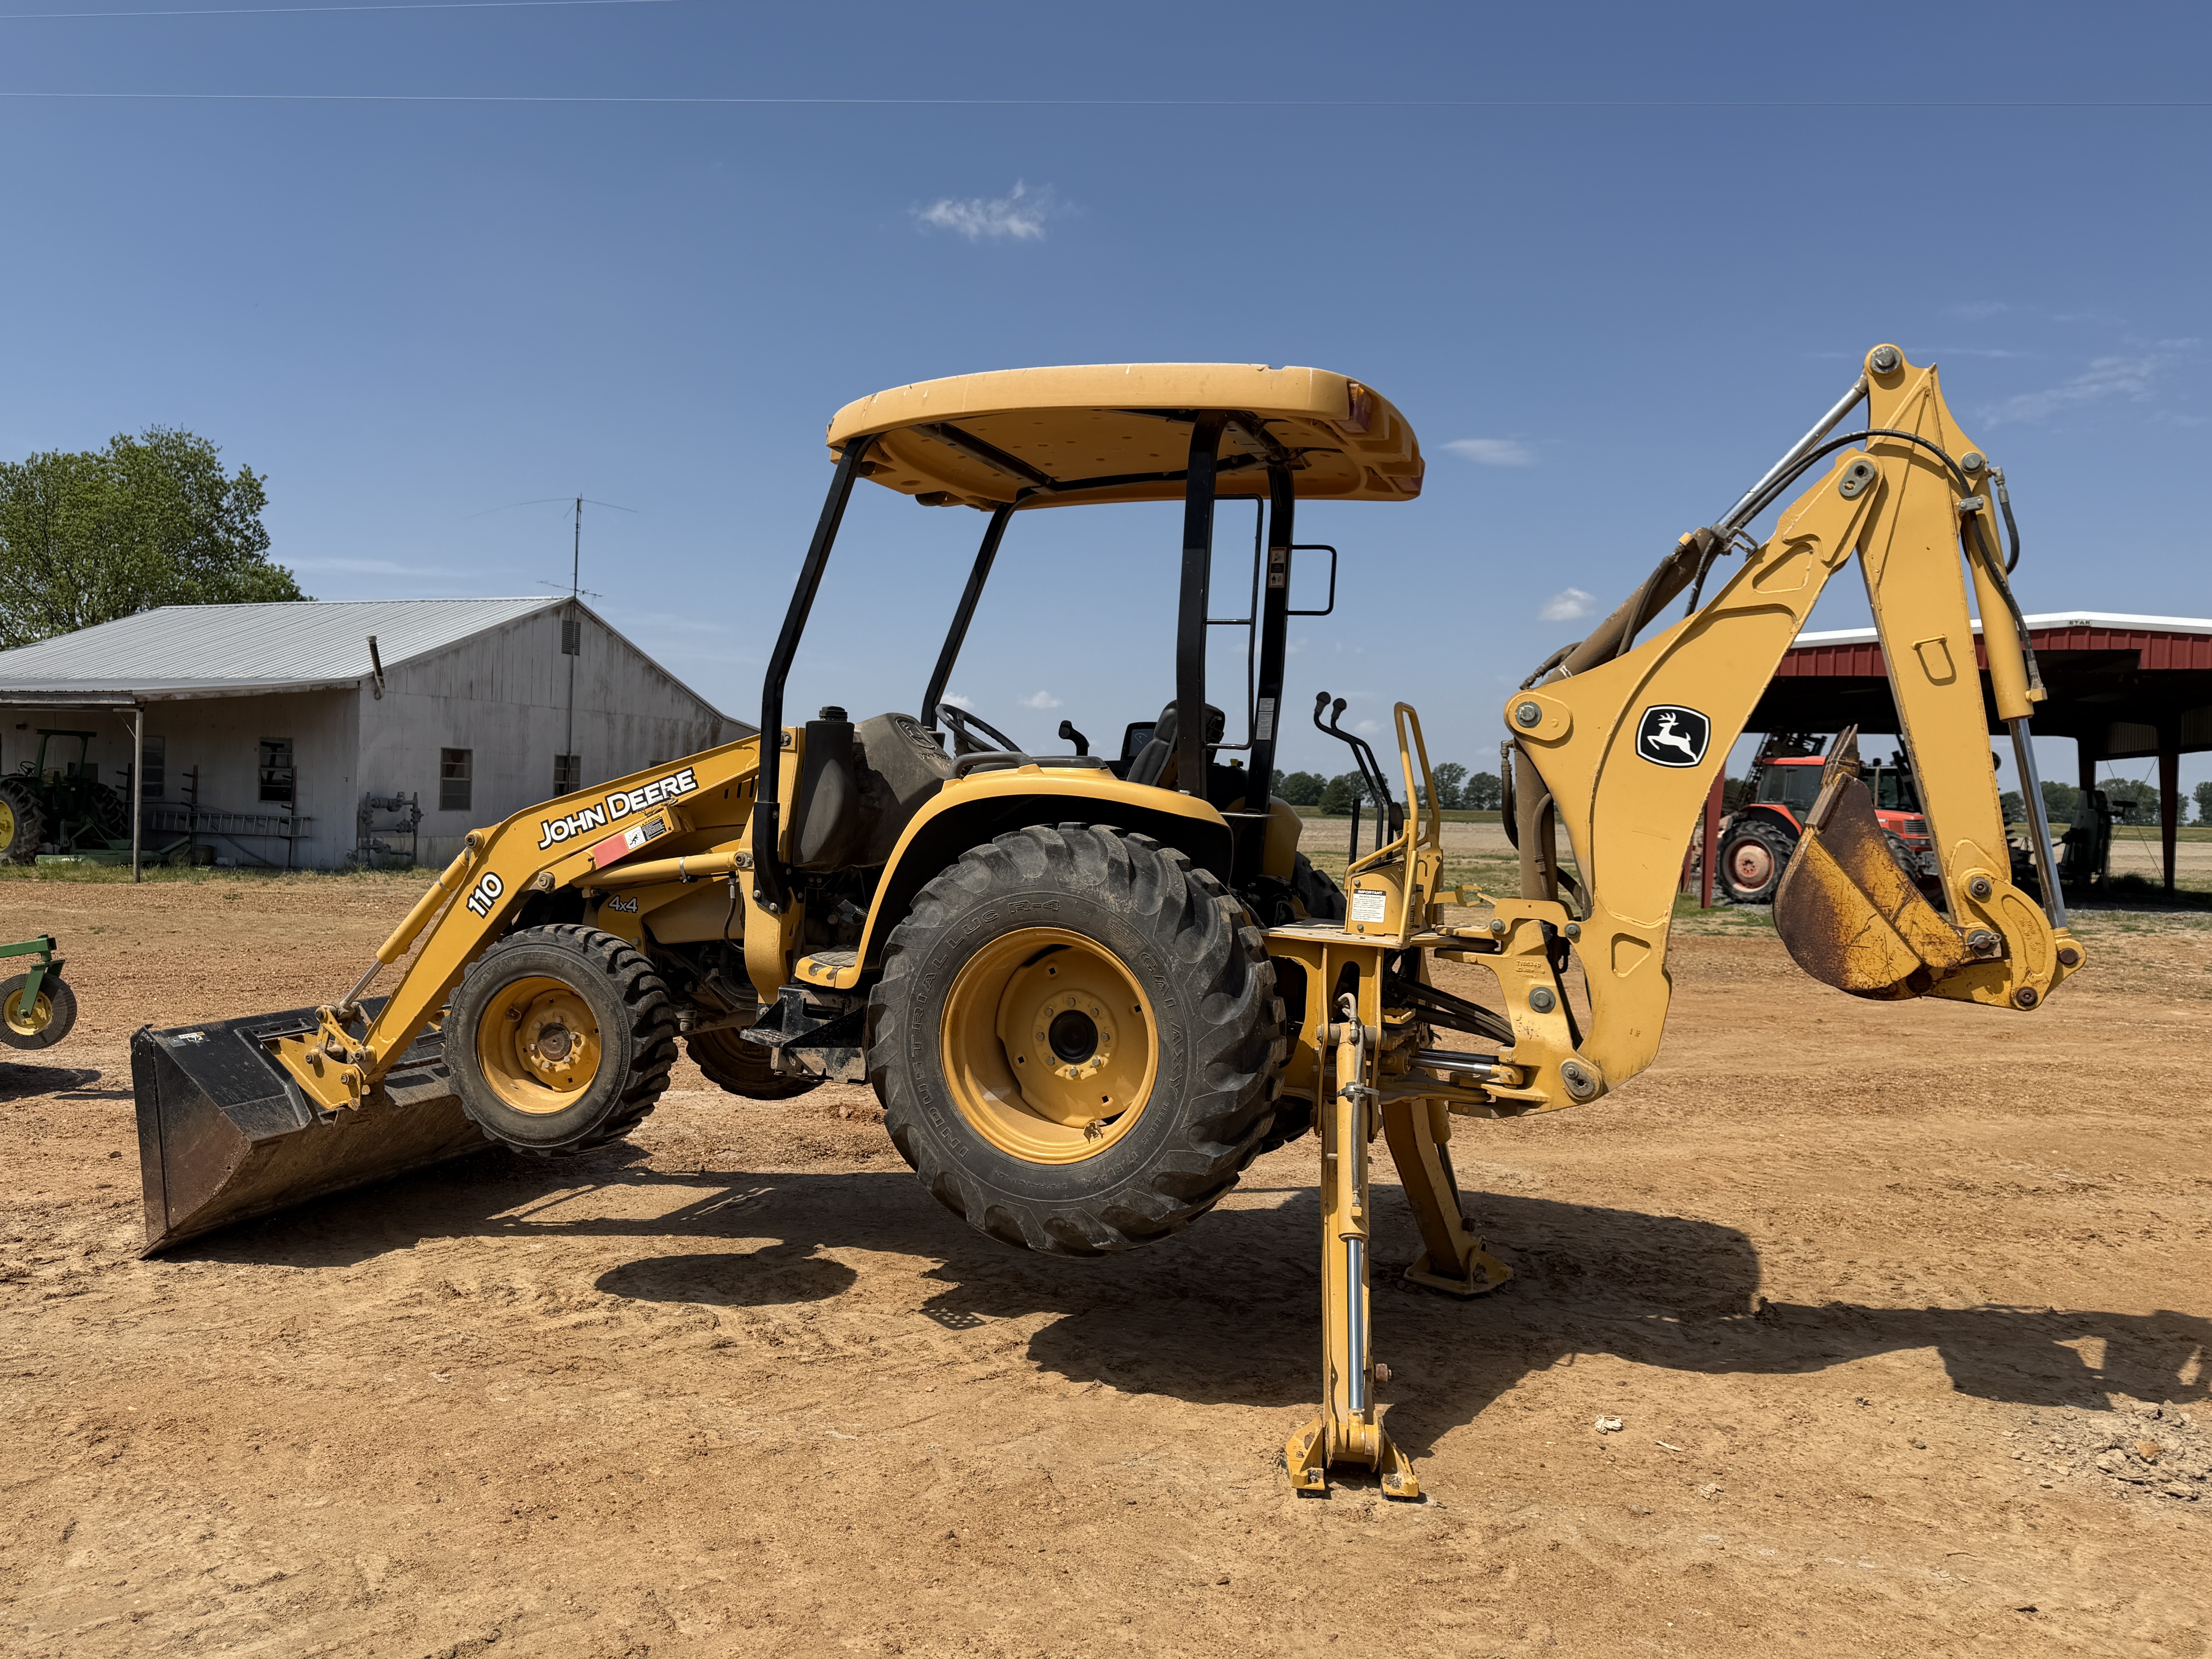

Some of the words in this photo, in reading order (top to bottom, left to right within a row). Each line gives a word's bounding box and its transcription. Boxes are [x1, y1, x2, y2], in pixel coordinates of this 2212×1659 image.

[539, 805, 606, 849] JOHN
[606, 769, 697, 818] DEERE
[468, 873, 503, 917] 110
[608, 896, 638, 912] 4x4
[911, 954, 969, 1159] INDUSTRIAL
[1008, 900, 1061, 914] R-4
[1140, 952, 1183, 1100] GALAXY
[1142, 1103, 1170, 1144] TUBELESS
